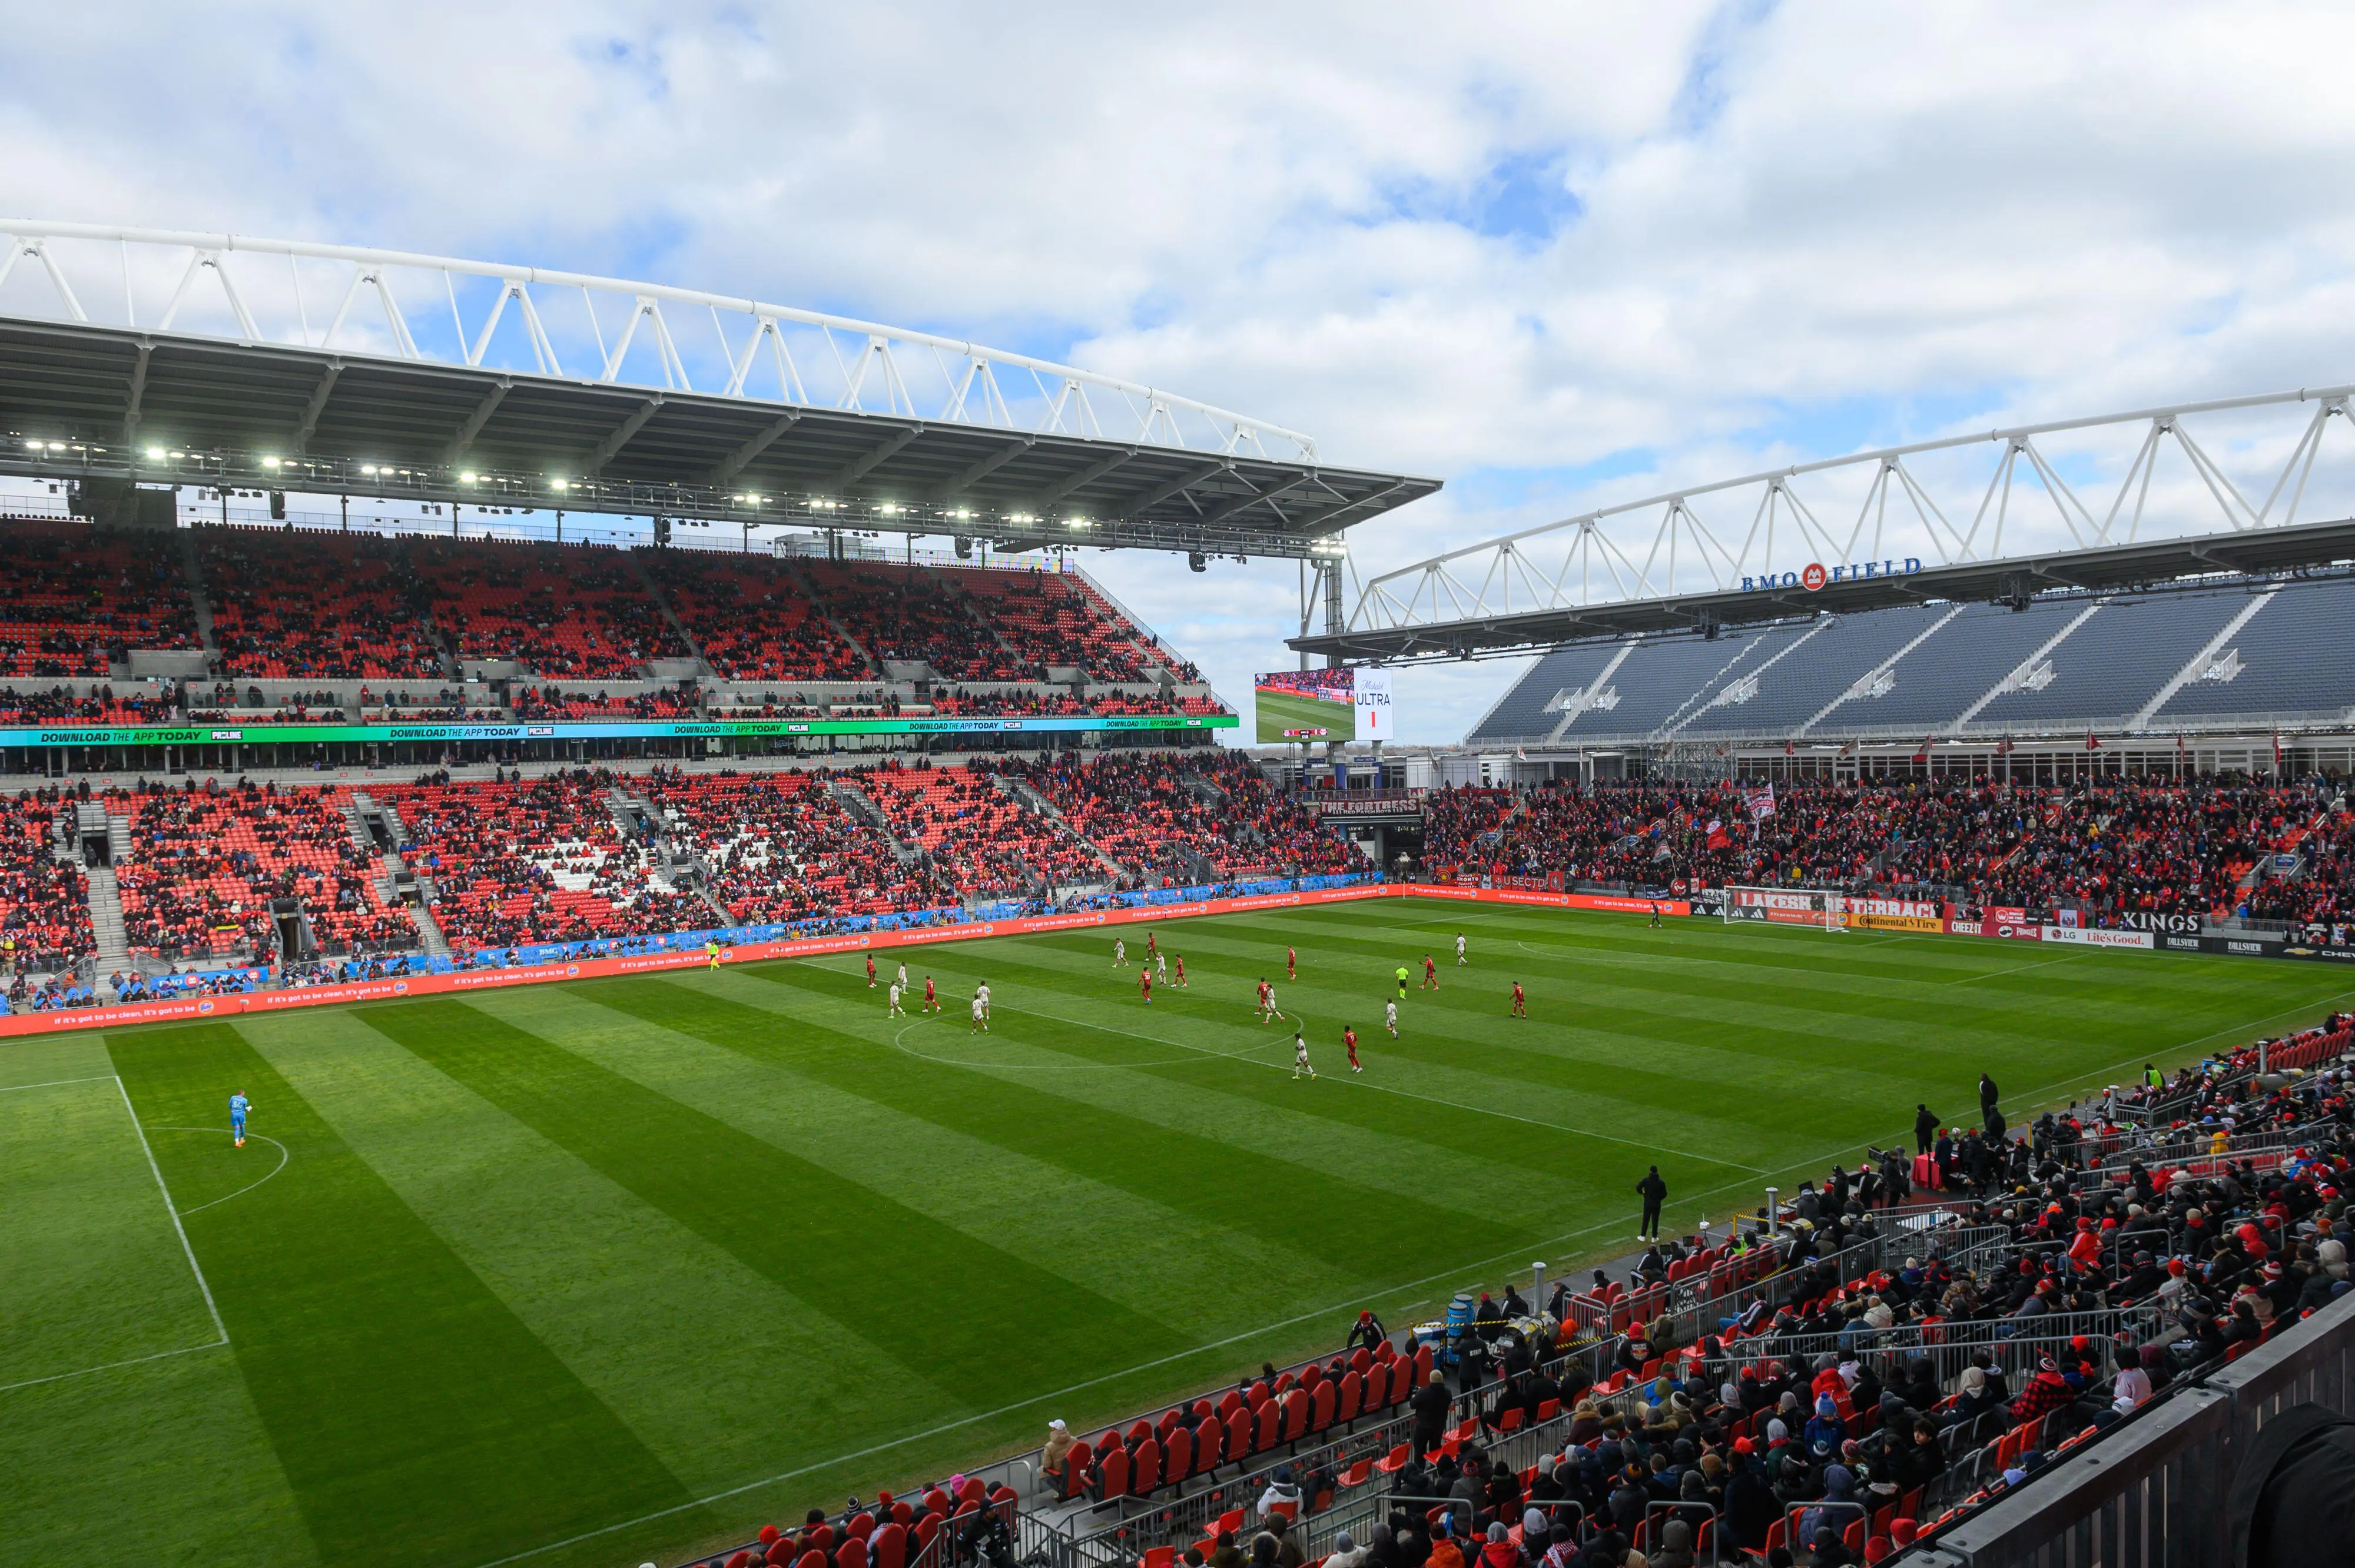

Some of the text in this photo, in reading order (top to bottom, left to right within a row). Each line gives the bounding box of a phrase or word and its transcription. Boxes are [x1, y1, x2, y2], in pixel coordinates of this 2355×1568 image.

[1742, 557, 1921, 592] BMO FIELD
[1356, 693, 1390, 705] ULTRA
[41, 732, 201, 742] DOWNLOAD THE APP TODAY
[1320, 799, 1417, 813] THE FORTRESS
[1742, 892, 1846, 913] LAKESHRE
[1859, 915, 1936, 928] Continental Tire
[2122, 912, 2198, 932] KINGS
[2087, 932, 2111, 942] Life's
[2113, 934, 2144, 945] Good.
[2167, 937, 2199, 947] FALLSVIEW
[2228, 942, 2262, 952] FALLSVIEW
[78, 1015, 94, 1024] got
[1470, 1348, 1481, 1357] STAFF
